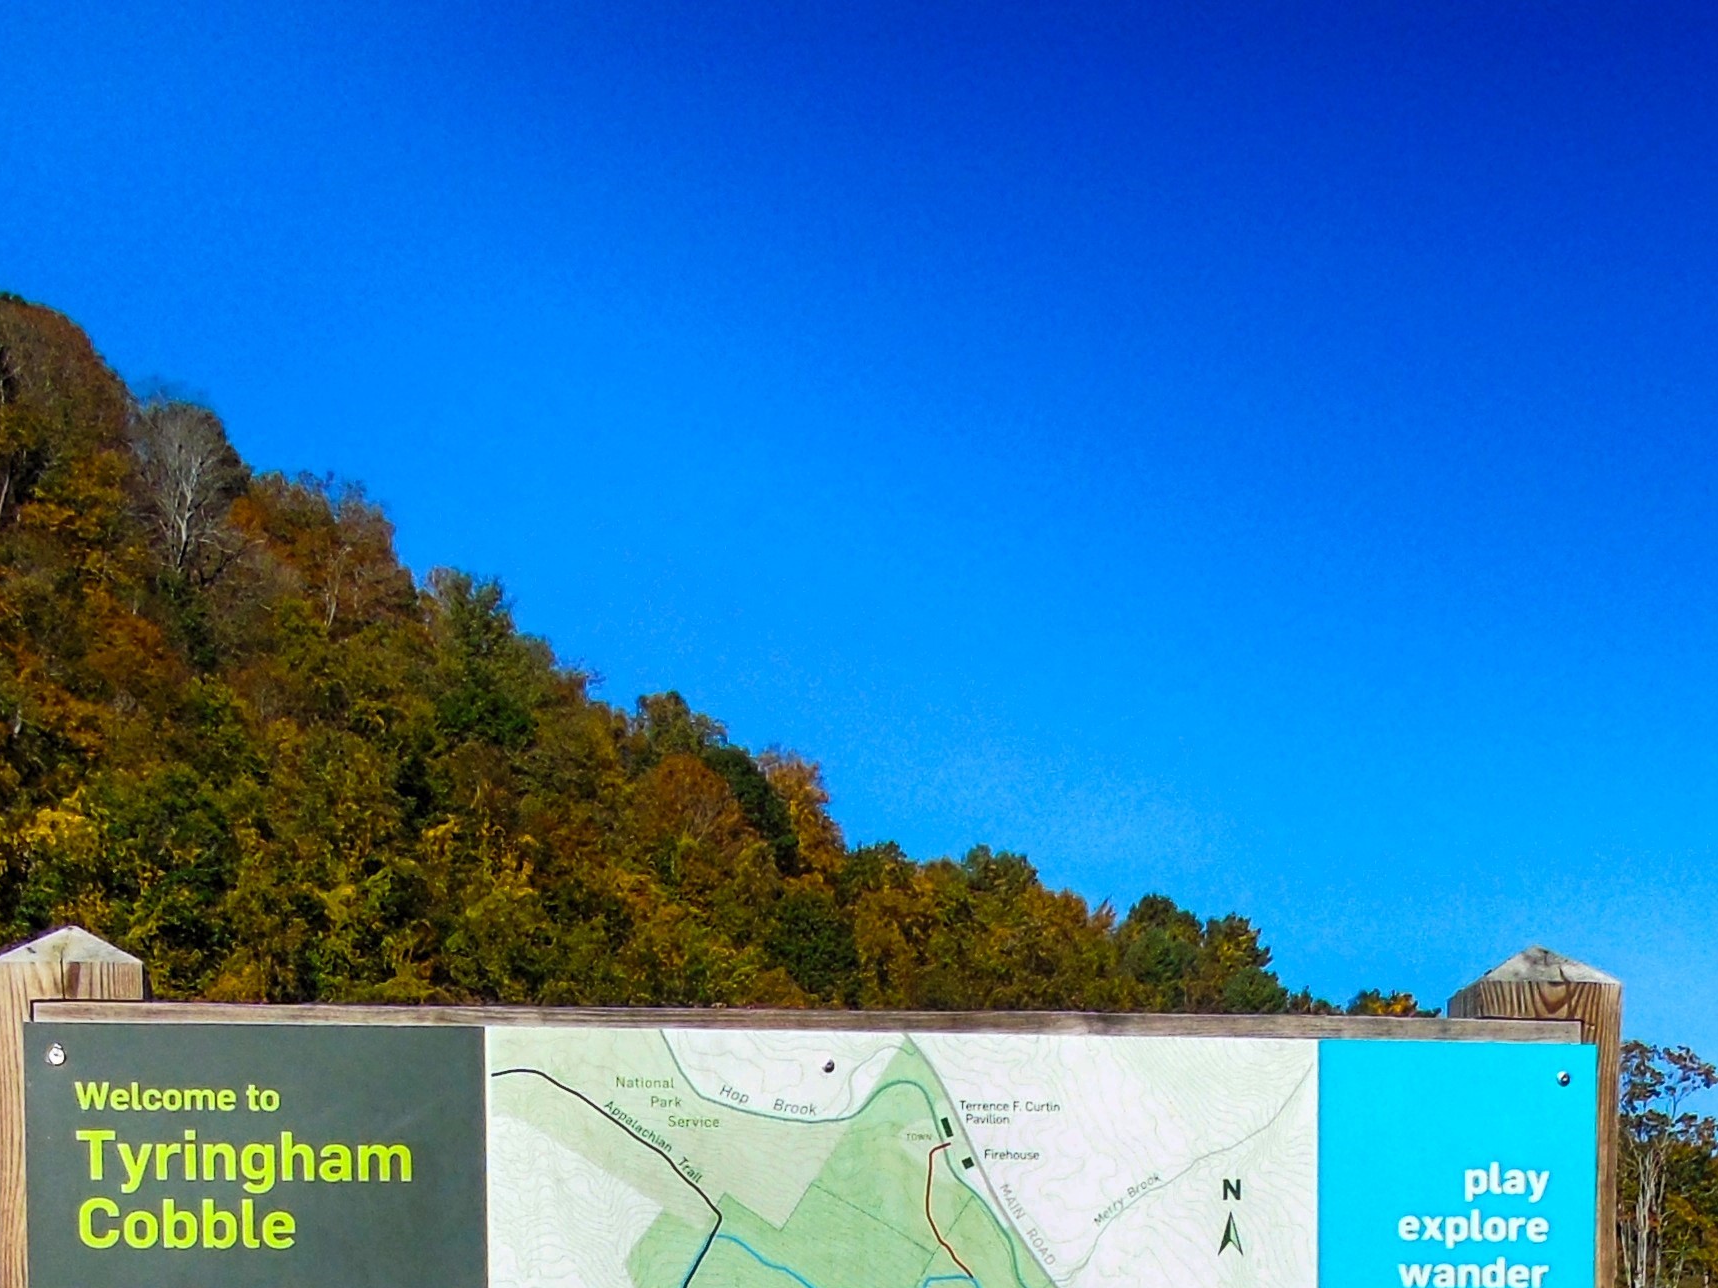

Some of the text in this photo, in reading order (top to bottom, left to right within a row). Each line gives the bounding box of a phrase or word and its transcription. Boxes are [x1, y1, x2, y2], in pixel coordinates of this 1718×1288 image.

[74, 1081, 279, 1111] Welcome to
[75, 1129, 410, 1193] Tyringham
[1222, 1178, 1240, 1200] N
[1464, 1161, 1549, 1202] play
[78, 1197, 295, 1248] Cobble
[1398, 1209, 1548, 1248] explore
[1398, 1256, 1549, 1288] wander
